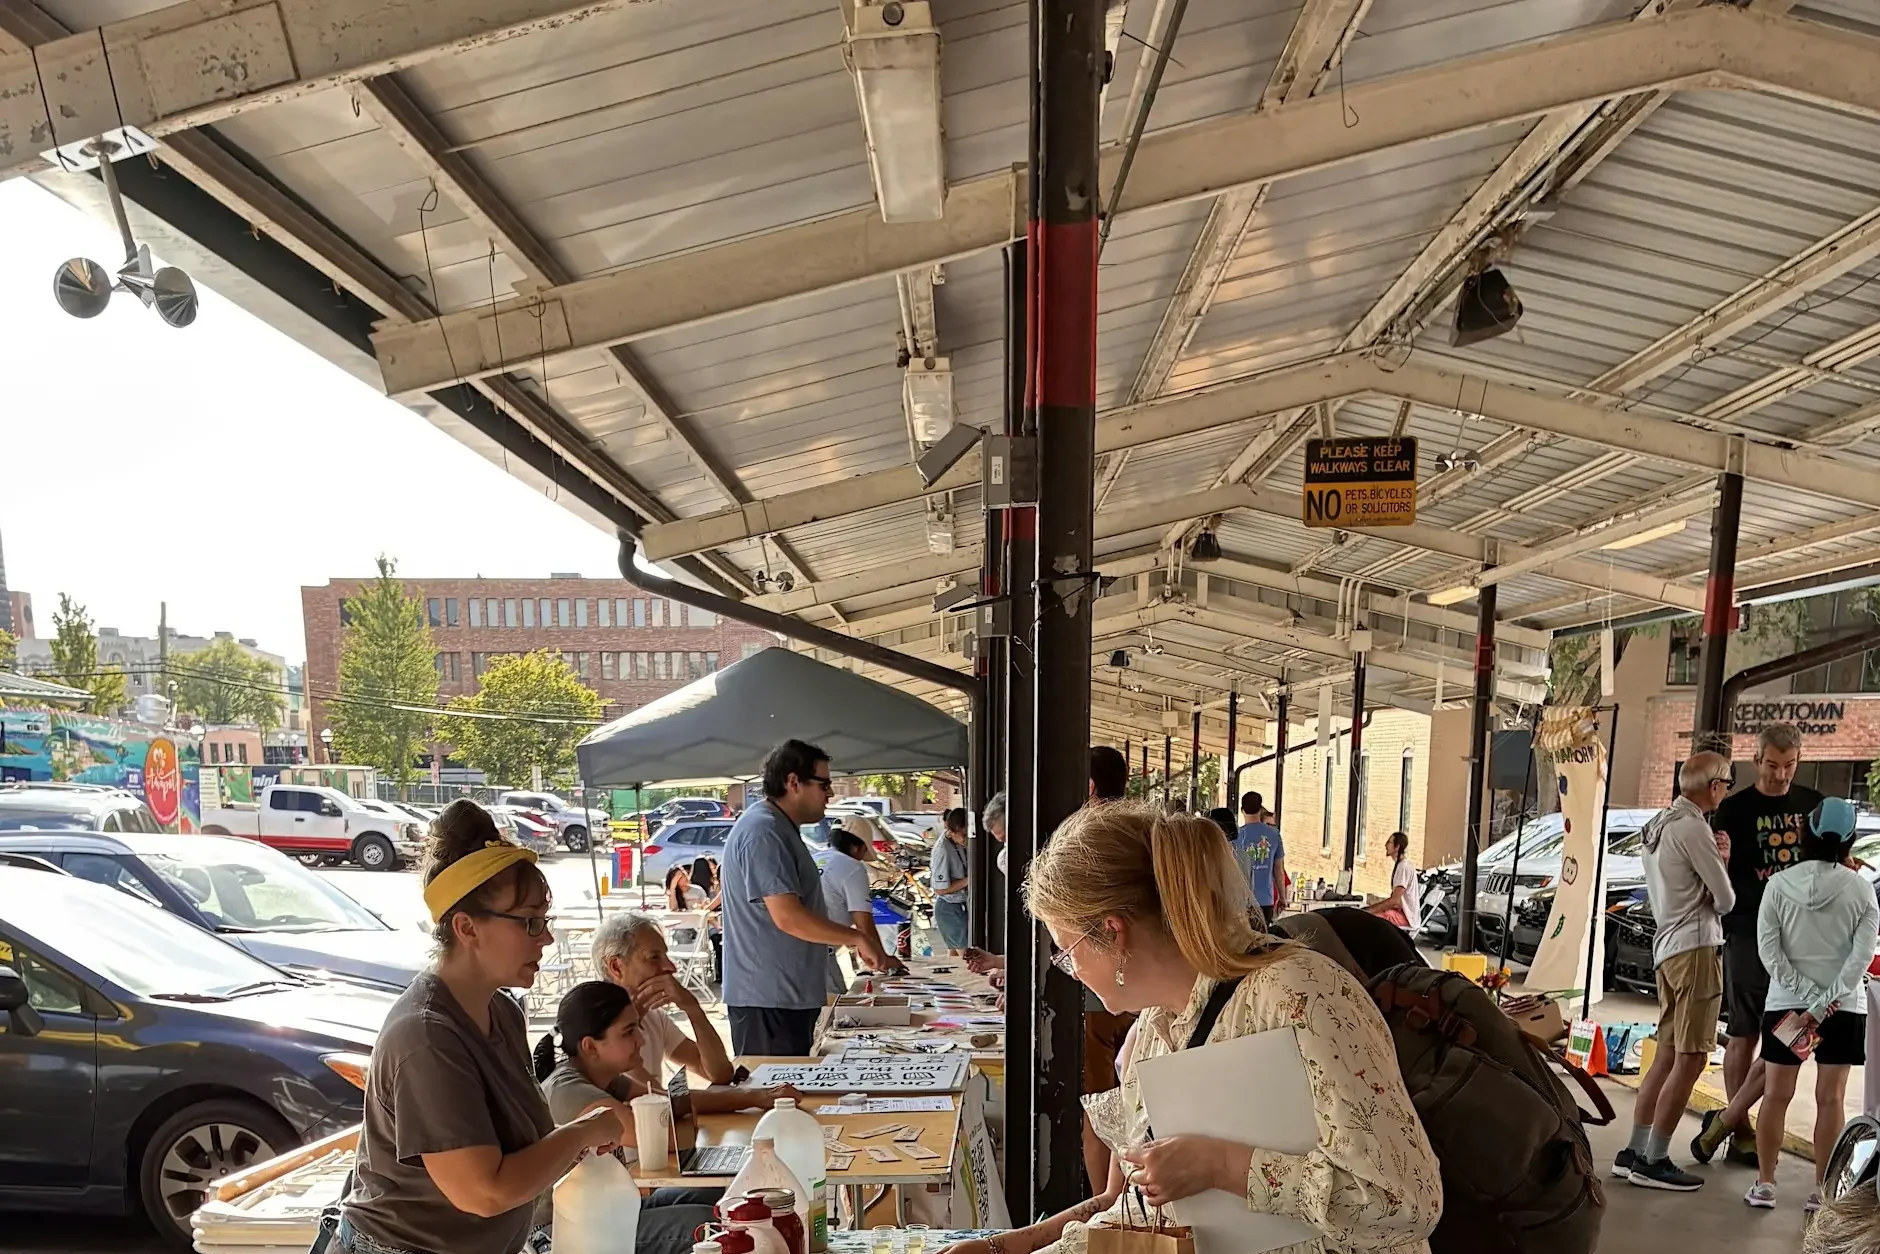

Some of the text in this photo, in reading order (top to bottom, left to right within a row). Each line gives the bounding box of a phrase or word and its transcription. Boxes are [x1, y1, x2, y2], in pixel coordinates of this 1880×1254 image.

[1320, 444, 1402, 458] PLEASE KEEP
[1310, 460, 1411, 474] WALKWAYS CLEAR
[1306, 489, 1342, 521] NO
[1345, 501, 1411, 514] OR SOLICITORS
[1756, 831, 1801, 848] FOO
[1764, 846, 1801, 863] NOT
[871, 1080, 936, 1088] Once
